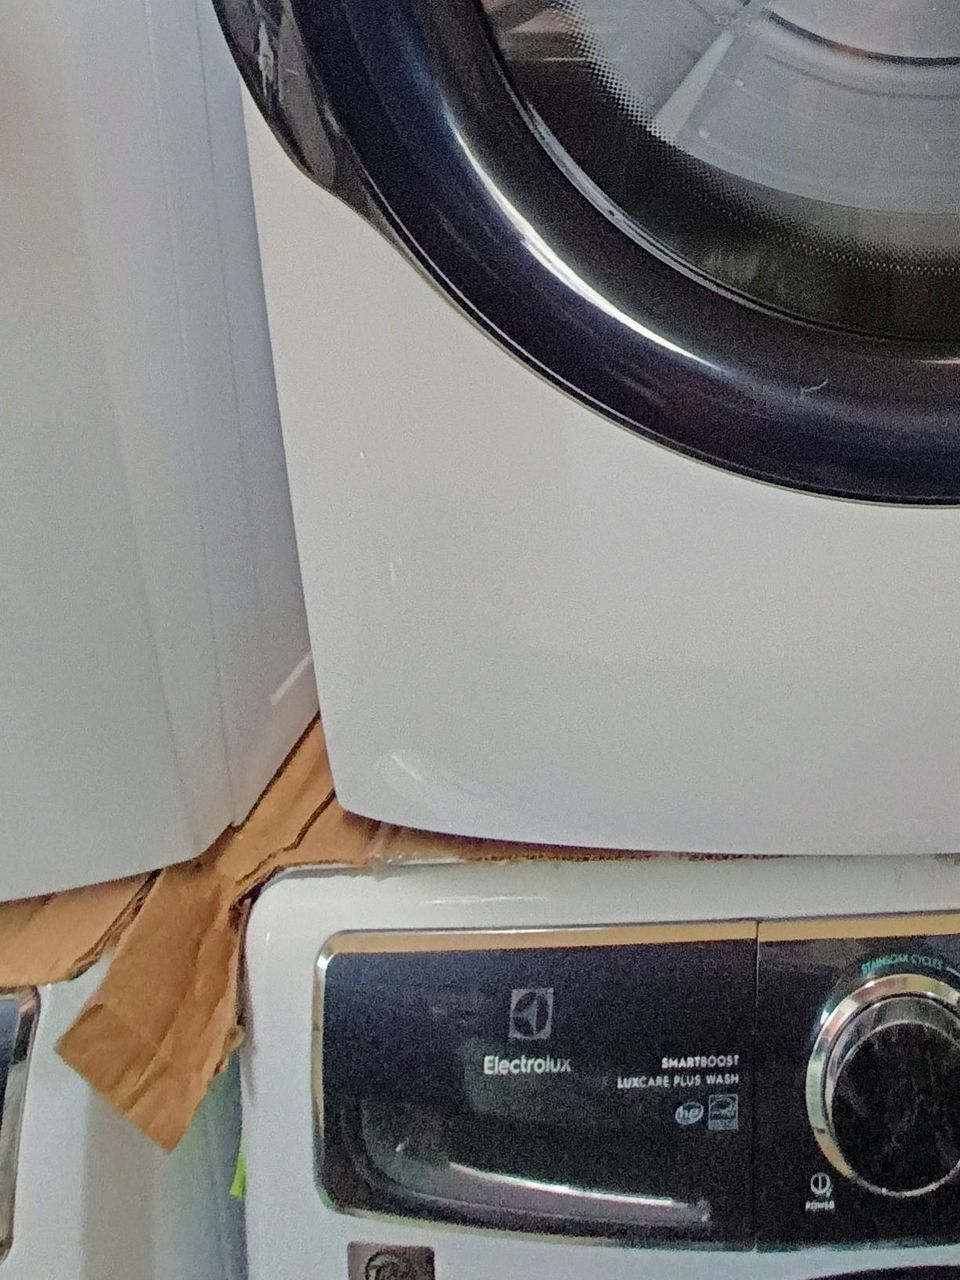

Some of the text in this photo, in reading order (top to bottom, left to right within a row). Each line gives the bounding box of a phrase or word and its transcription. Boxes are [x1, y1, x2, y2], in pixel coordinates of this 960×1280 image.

[483, 1055, 572, 1075] Electrolux
[661, 1055, 739, 1069] SMARTBOOST
[617, 1073, 739, 1089] LUXCARE PLUS WASH
